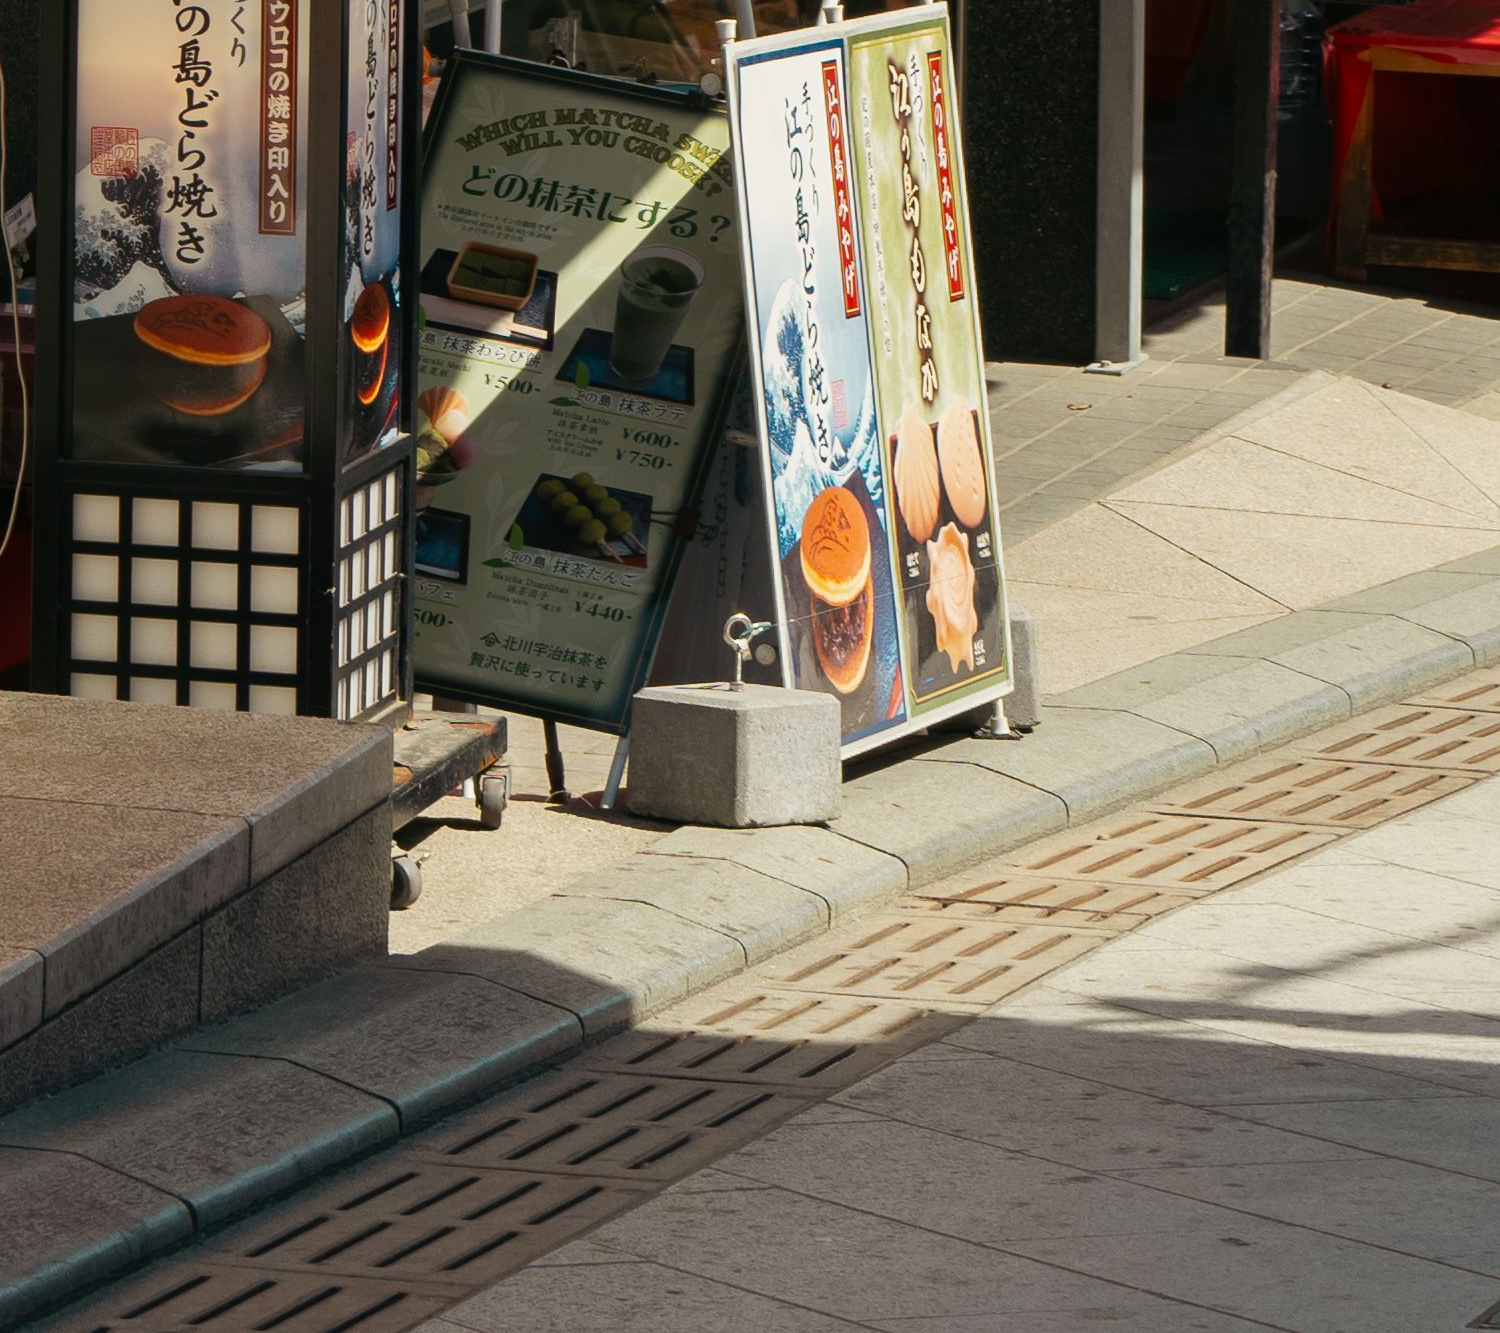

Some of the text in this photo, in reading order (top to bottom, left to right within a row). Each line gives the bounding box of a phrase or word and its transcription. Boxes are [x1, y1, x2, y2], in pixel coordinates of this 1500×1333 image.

[455, 110, 548, 153] WHICH
[552, 107, 671, 143] MATCHA
[498, 127, 723, 198] WILL YOU CHOOSE?
[826, 79, 858, 297] 江の島みやげ
[932, 70, 959, 283] 江の島みやげ
[461, 164, 731, 243] どの抹茶にする?
[783, 96, 829, 463] 江の島どら焼き
[442, 334, 544, 369] 抹茶わらび餅
[618, 397, 686, 422] 抹茶ラテ
[552, 558, 639, 589] 抹茶だんご
[501, 635, 608, 670] 北川宇治抹茶を
